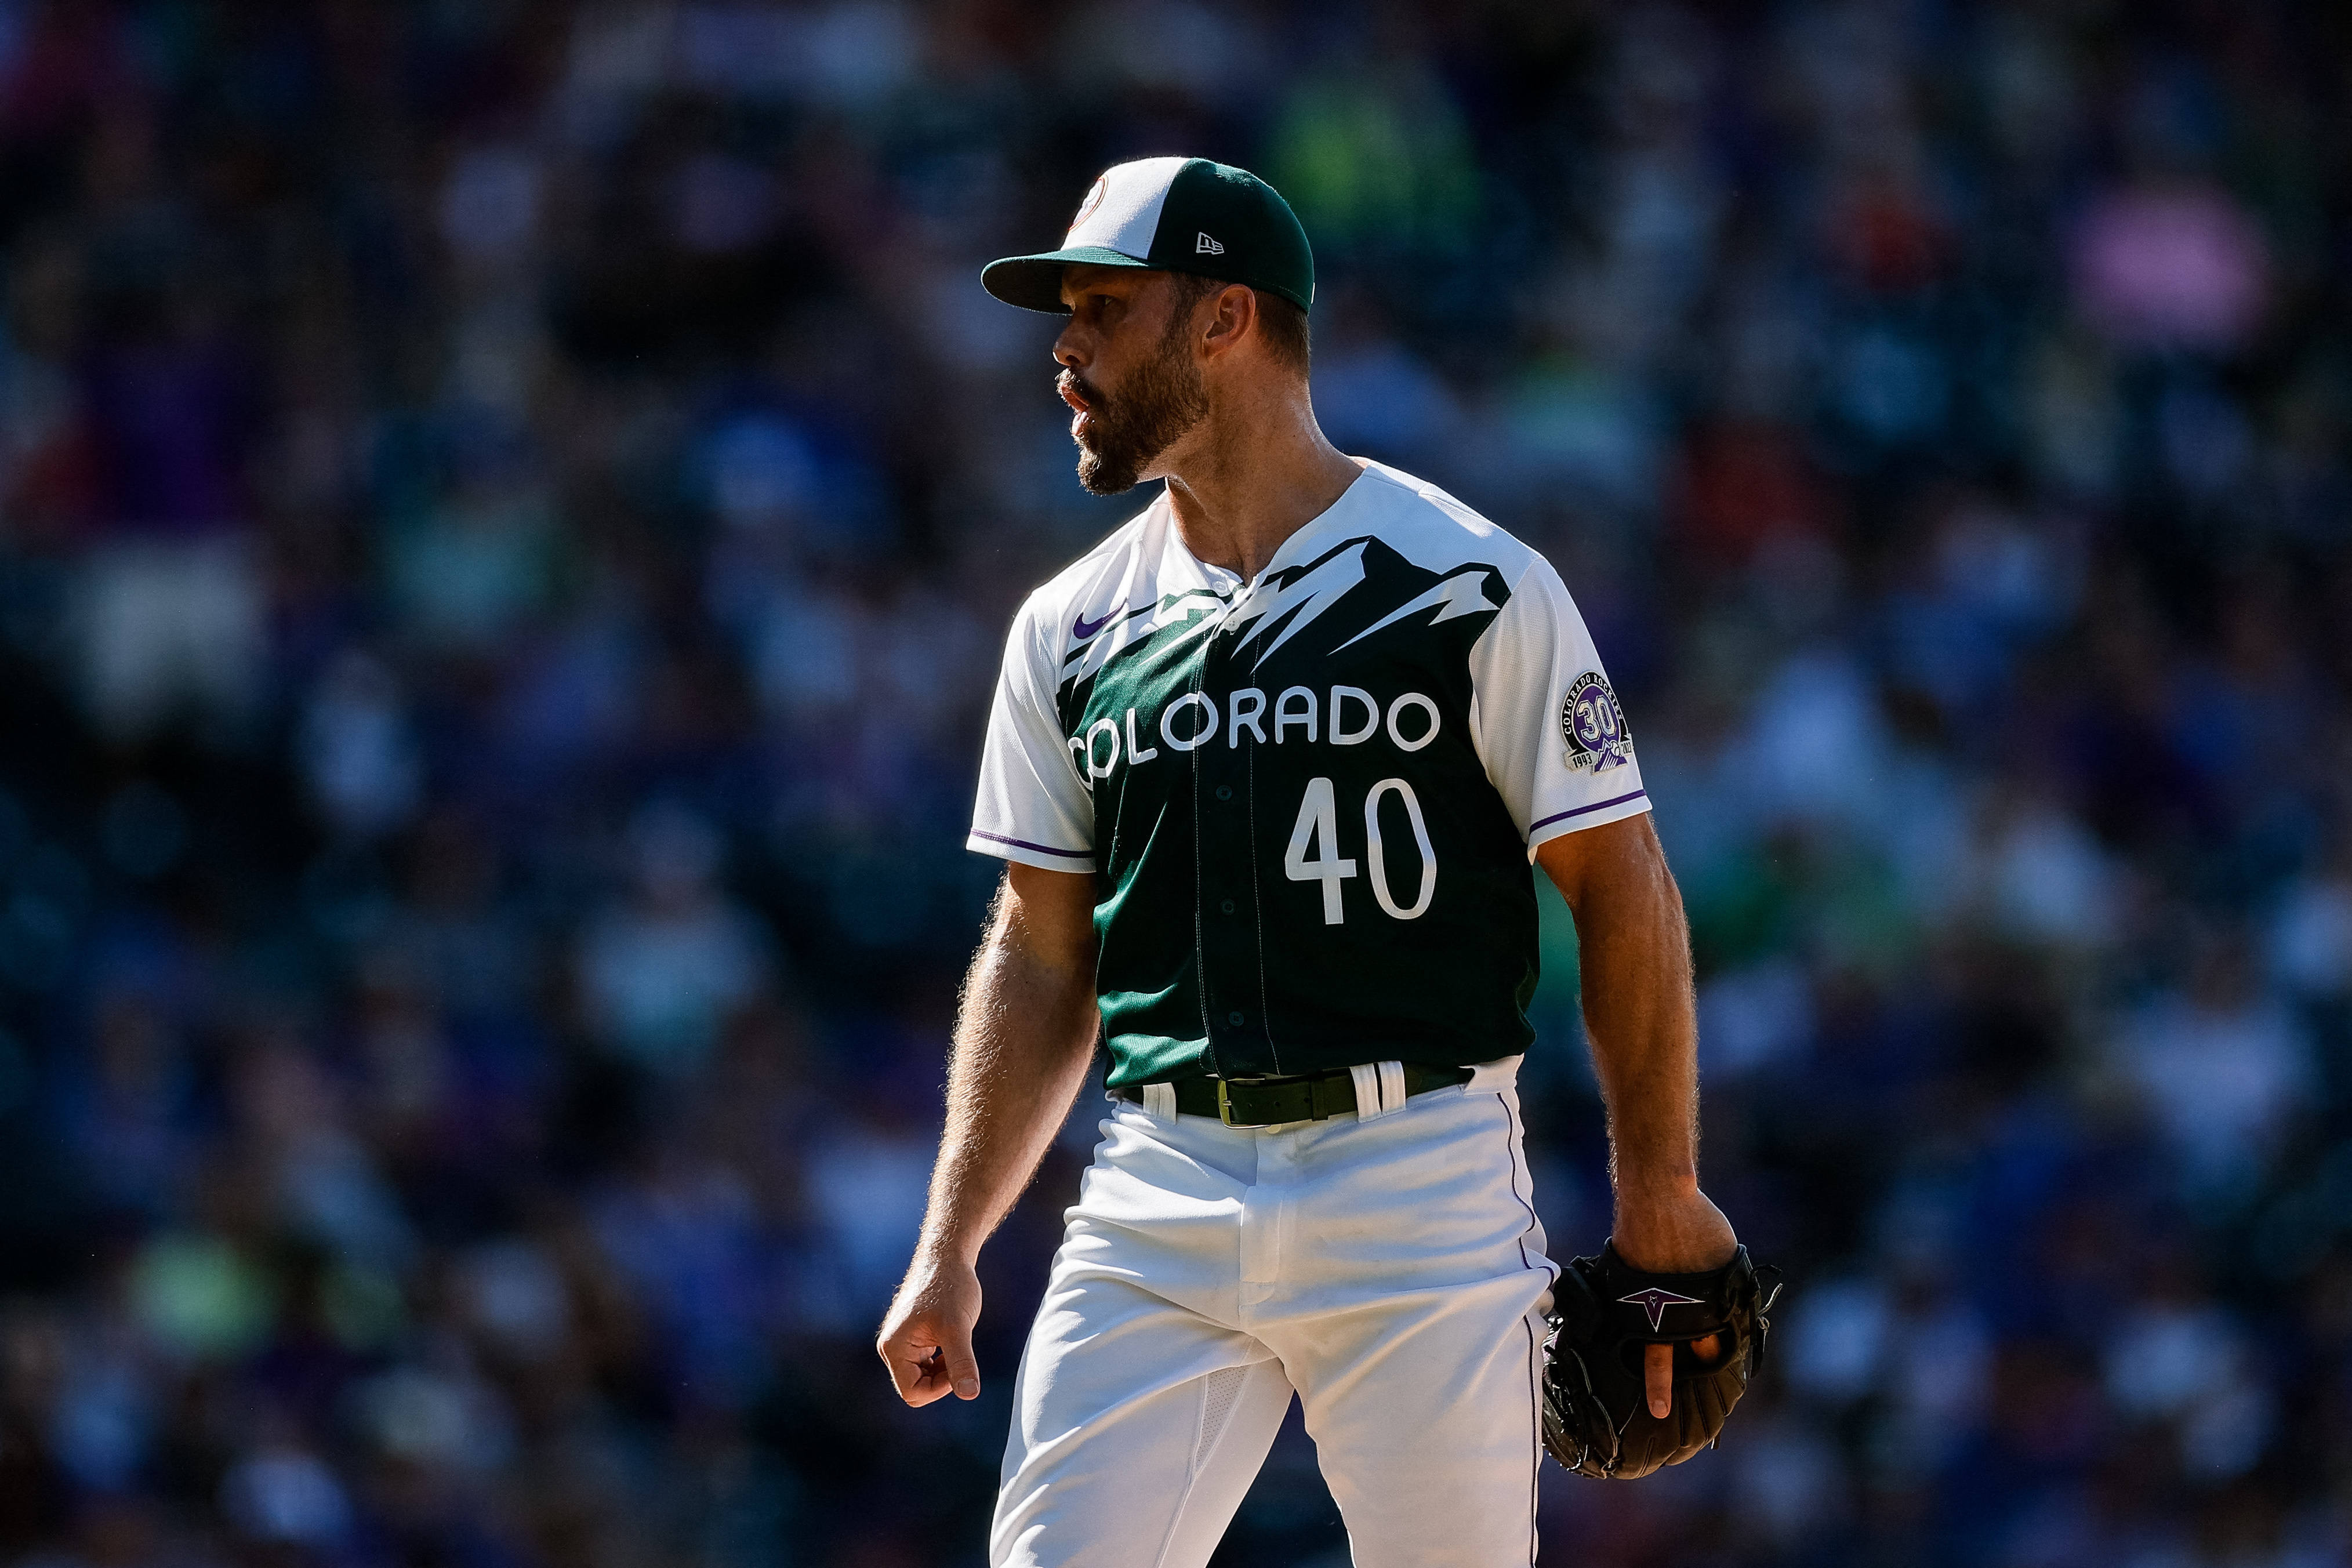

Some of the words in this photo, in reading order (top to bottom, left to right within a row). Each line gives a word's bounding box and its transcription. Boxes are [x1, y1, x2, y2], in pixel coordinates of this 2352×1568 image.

[1563, 674, 1591, 735] COLORADO
[1594, 674, 1623, 720] ROCKIES
[1576, 695, 1617, 742] 30
[1068, 685, 1440, 792] COLORADO
[1573, 754, 1592, 768] 1993
[1284, 777, 1437, 925] 40
